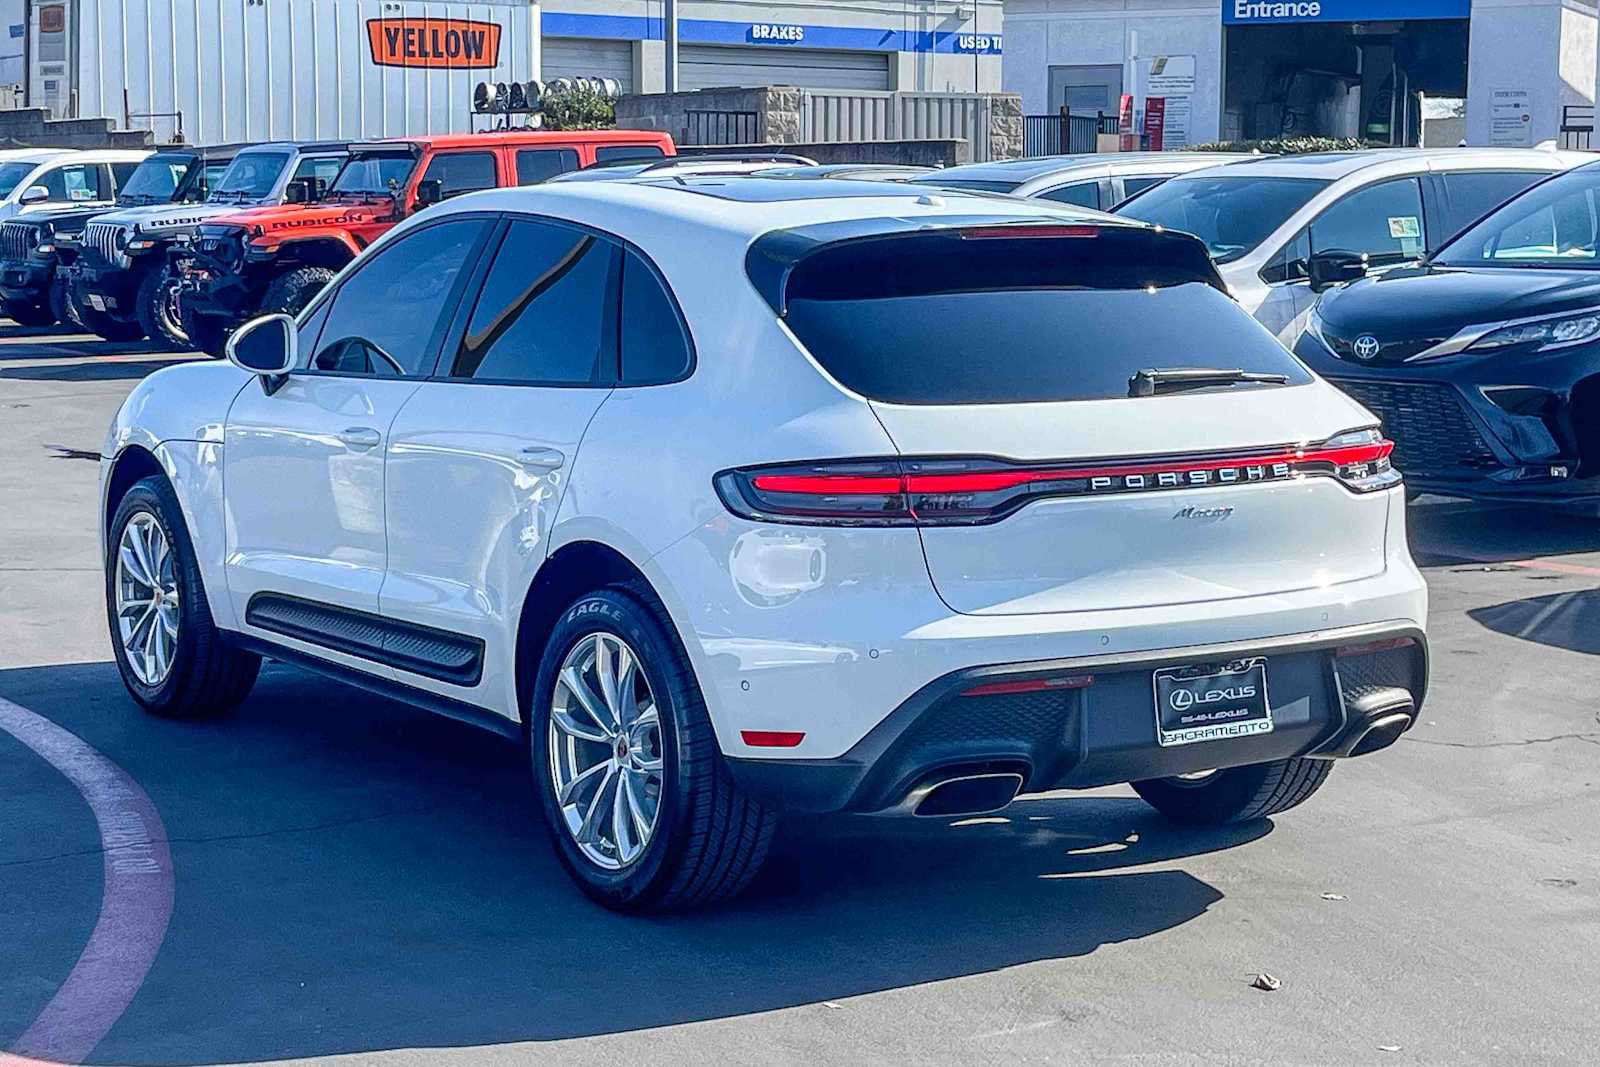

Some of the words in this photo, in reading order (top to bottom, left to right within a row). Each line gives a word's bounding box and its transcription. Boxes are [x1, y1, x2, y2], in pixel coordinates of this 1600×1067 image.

[1234, 0, 1321, 18] Entrance
[752, 24, 804, 40] BRAKES
[384, 26, 486, 60] YELLOW
[959, 35, 991, 50] USED
[271, 214, 364, 230] RUBICON
[1091, 462, 1289, 490] PORSCHE
[567, 601, 625, 623] EAGLE
[1194, 685, 1257, 704] LEXUS
[1163, 721, 1270, 743] SACRAMENTO
